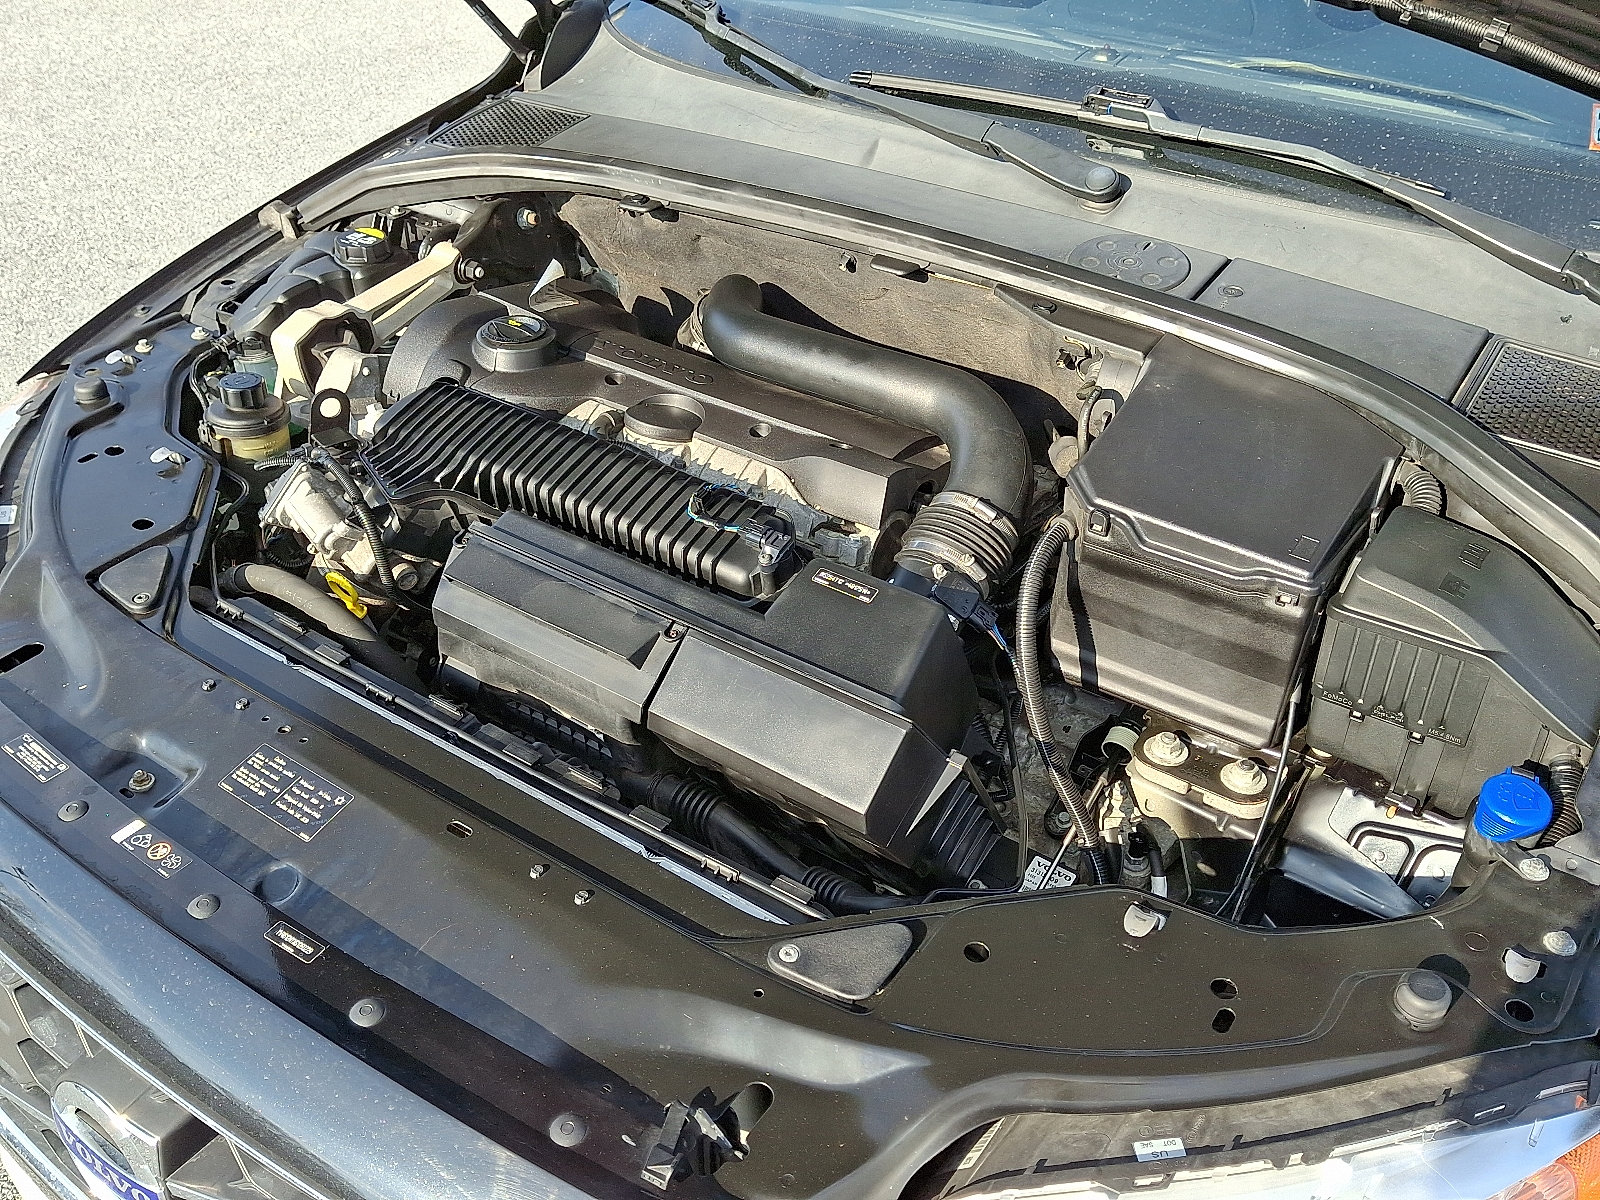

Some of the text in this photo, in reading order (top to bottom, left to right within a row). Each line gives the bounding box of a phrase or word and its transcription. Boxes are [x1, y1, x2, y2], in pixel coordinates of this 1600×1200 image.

[1322, 690, 1353, 705] FoMoCo
[1163, 1139, 1177, 1147] DOT
[1151, 1150, 1169, 1159] US
